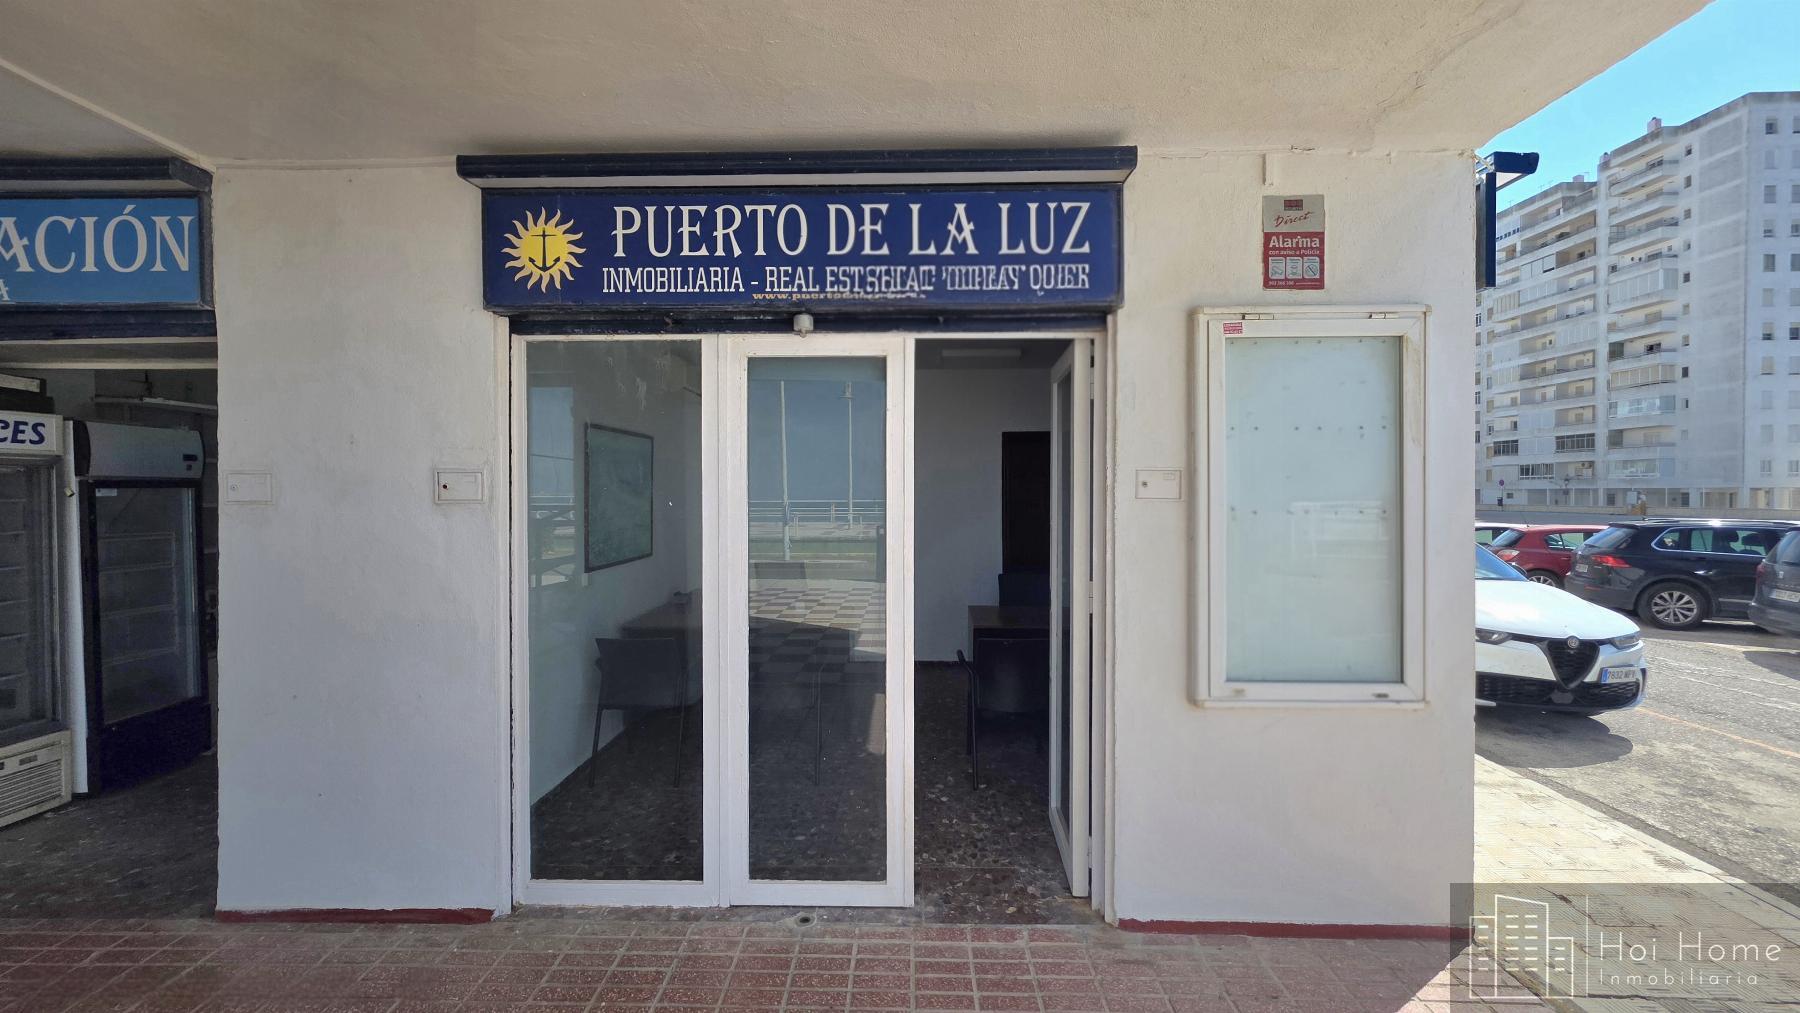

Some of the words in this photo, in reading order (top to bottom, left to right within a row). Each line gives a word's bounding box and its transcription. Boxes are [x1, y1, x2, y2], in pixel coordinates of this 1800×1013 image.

[611, 203, 808, 258] PUERTO
[827, 203, 889, 256] DE
[908, 202, 979, 256] LA
[997, 202, 1091, 255] LUZ
[1269, 235, 1320, 248] Alarma
[602, 267, 745, 292] INMOBILIARIA
[765, 266, 819, 292] REAL
